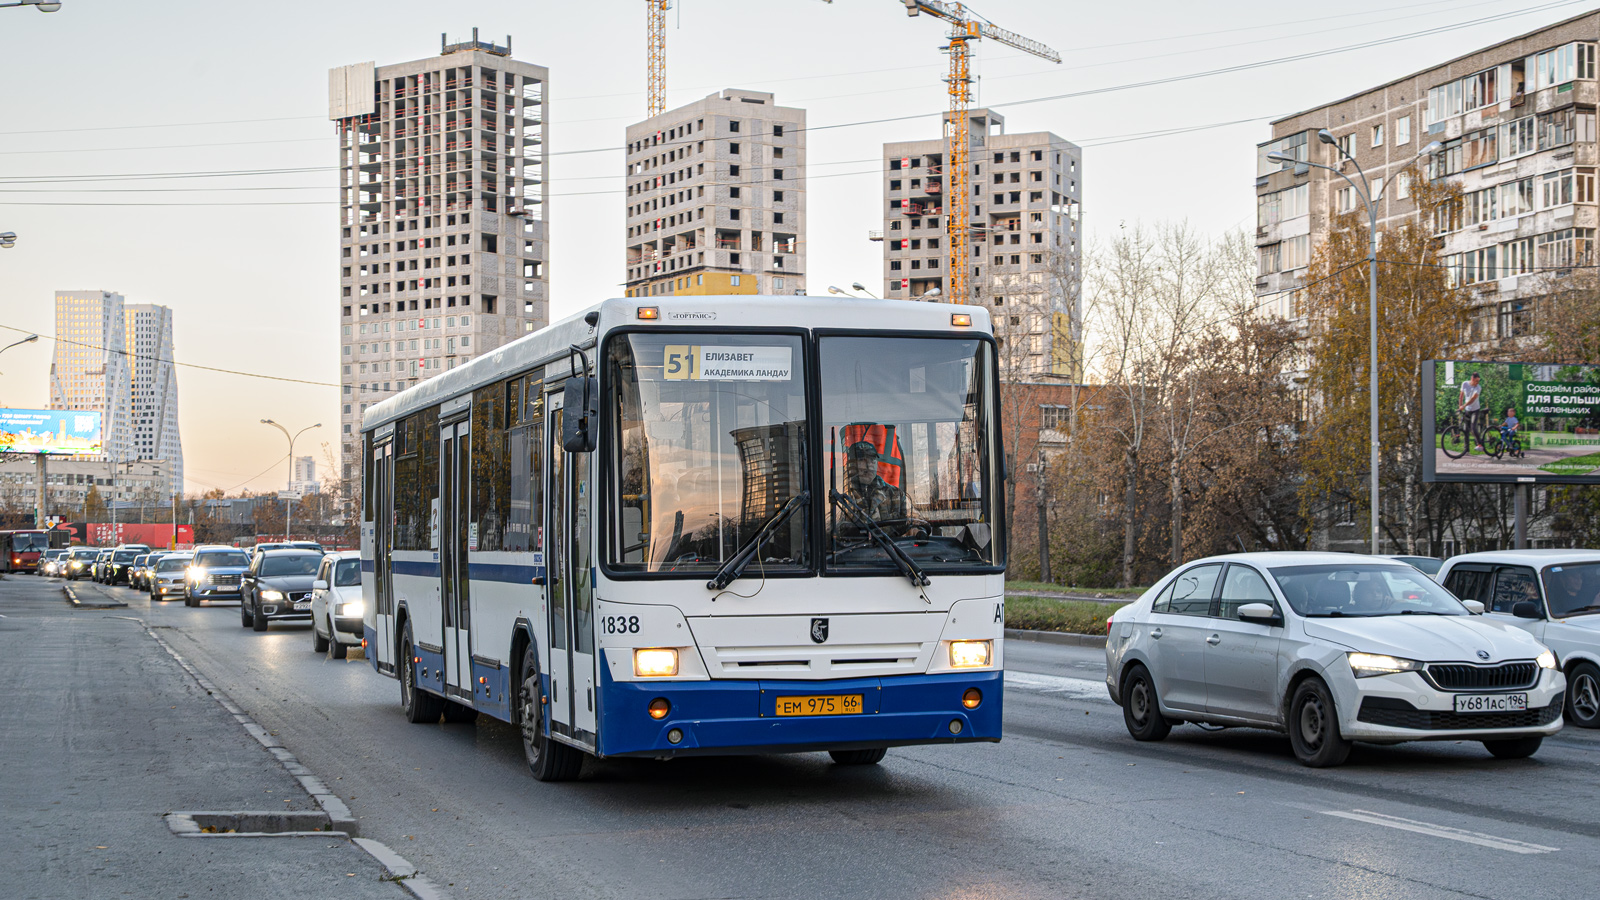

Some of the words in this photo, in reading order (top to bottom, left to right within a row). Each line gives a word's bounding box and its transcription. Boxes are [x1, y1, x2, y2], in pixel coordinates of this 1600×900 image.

[705, 352, 754, 361] ЕЛИЗАВЕТ
[667, 353, 694, 374] 51
[704, 369, 754, 377] АКАДЕМИКА
[756, 369, 789, 377] ЛАНДАУ
[1527, 383, 1571, 393] Создаём
[1536, 406, 1591, 414] маленьких
[601, 615, 640, 634] 1838
[784, 702, 802, 713] ЕМ
[808, 698, 835, 712] 975
[843, 696, 857, 707] 66
[1507, 695, 1523, 705] 196
